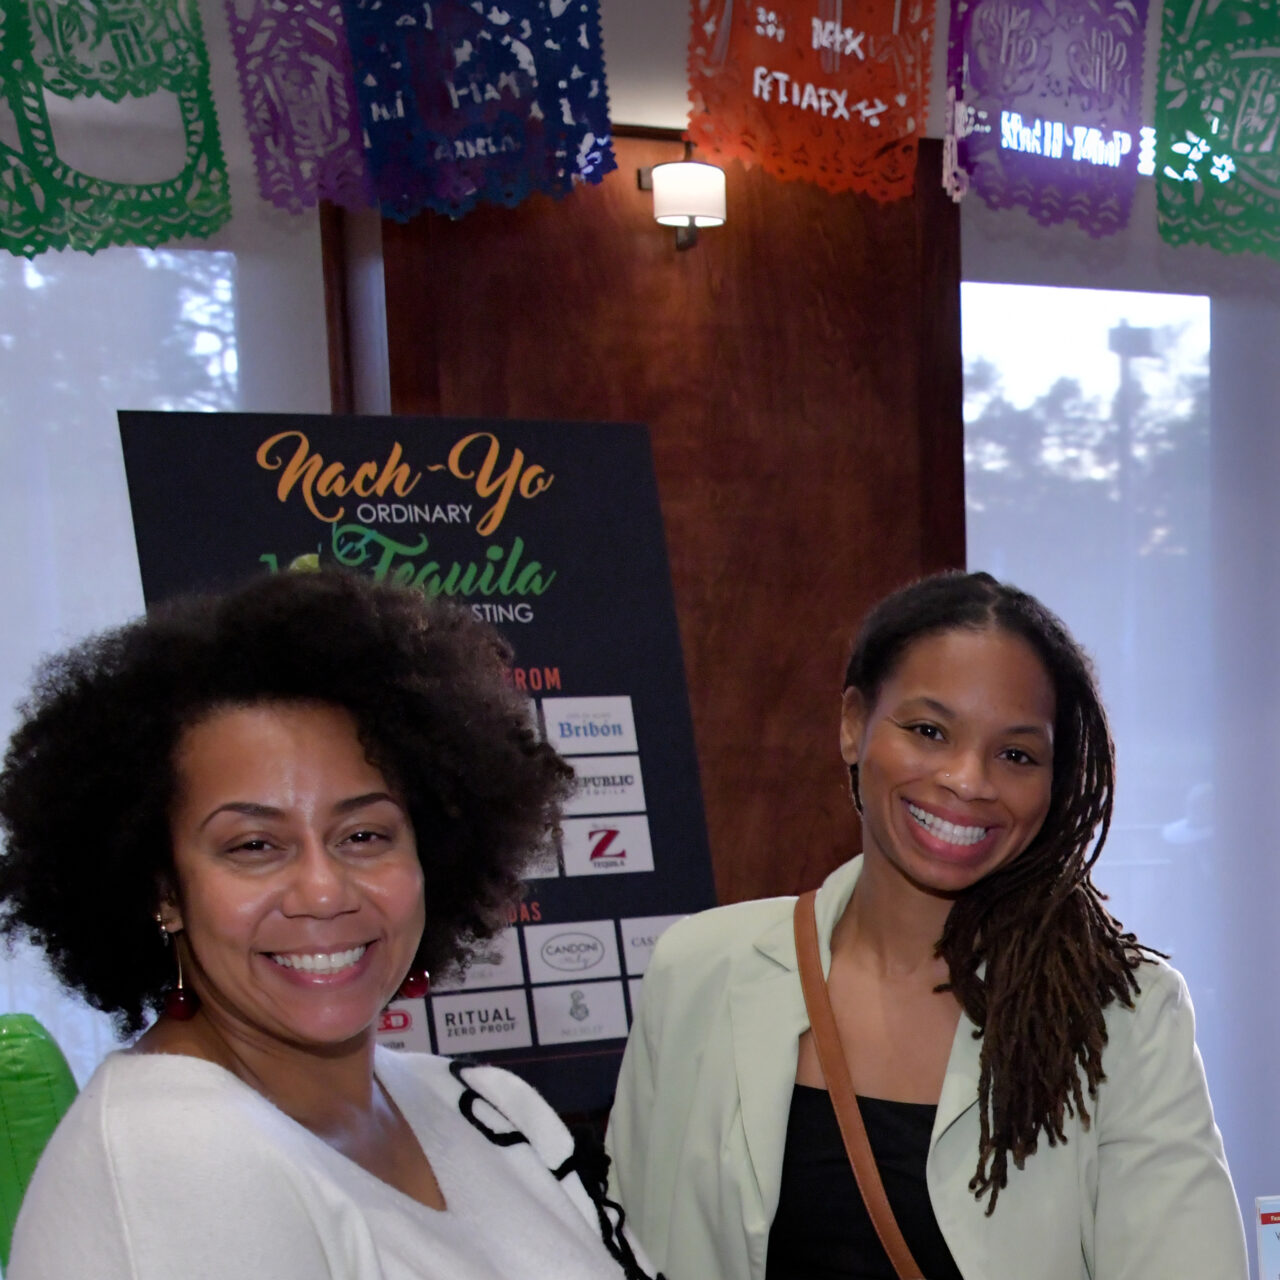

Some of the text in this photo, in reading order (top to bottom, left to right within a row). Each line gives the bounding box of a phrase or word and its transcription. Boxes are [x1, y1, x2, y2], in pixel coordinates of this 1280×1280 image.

[256, 431, 554, 536] Nach-Yo
[357, 503, 472, 524] ORDINARY
[331, 522, 556, 600] Tequila
[471, 603, 534, 623] STING
[574, 774, 634, 789] EPUBLIC
[588, 829, 627, 861] Z
[545, 942, 598, 957] CANDONI
[445, 1007, 516, 1027] RITUAL
[447, 1021, 516, 1038] ZERO PROOF
